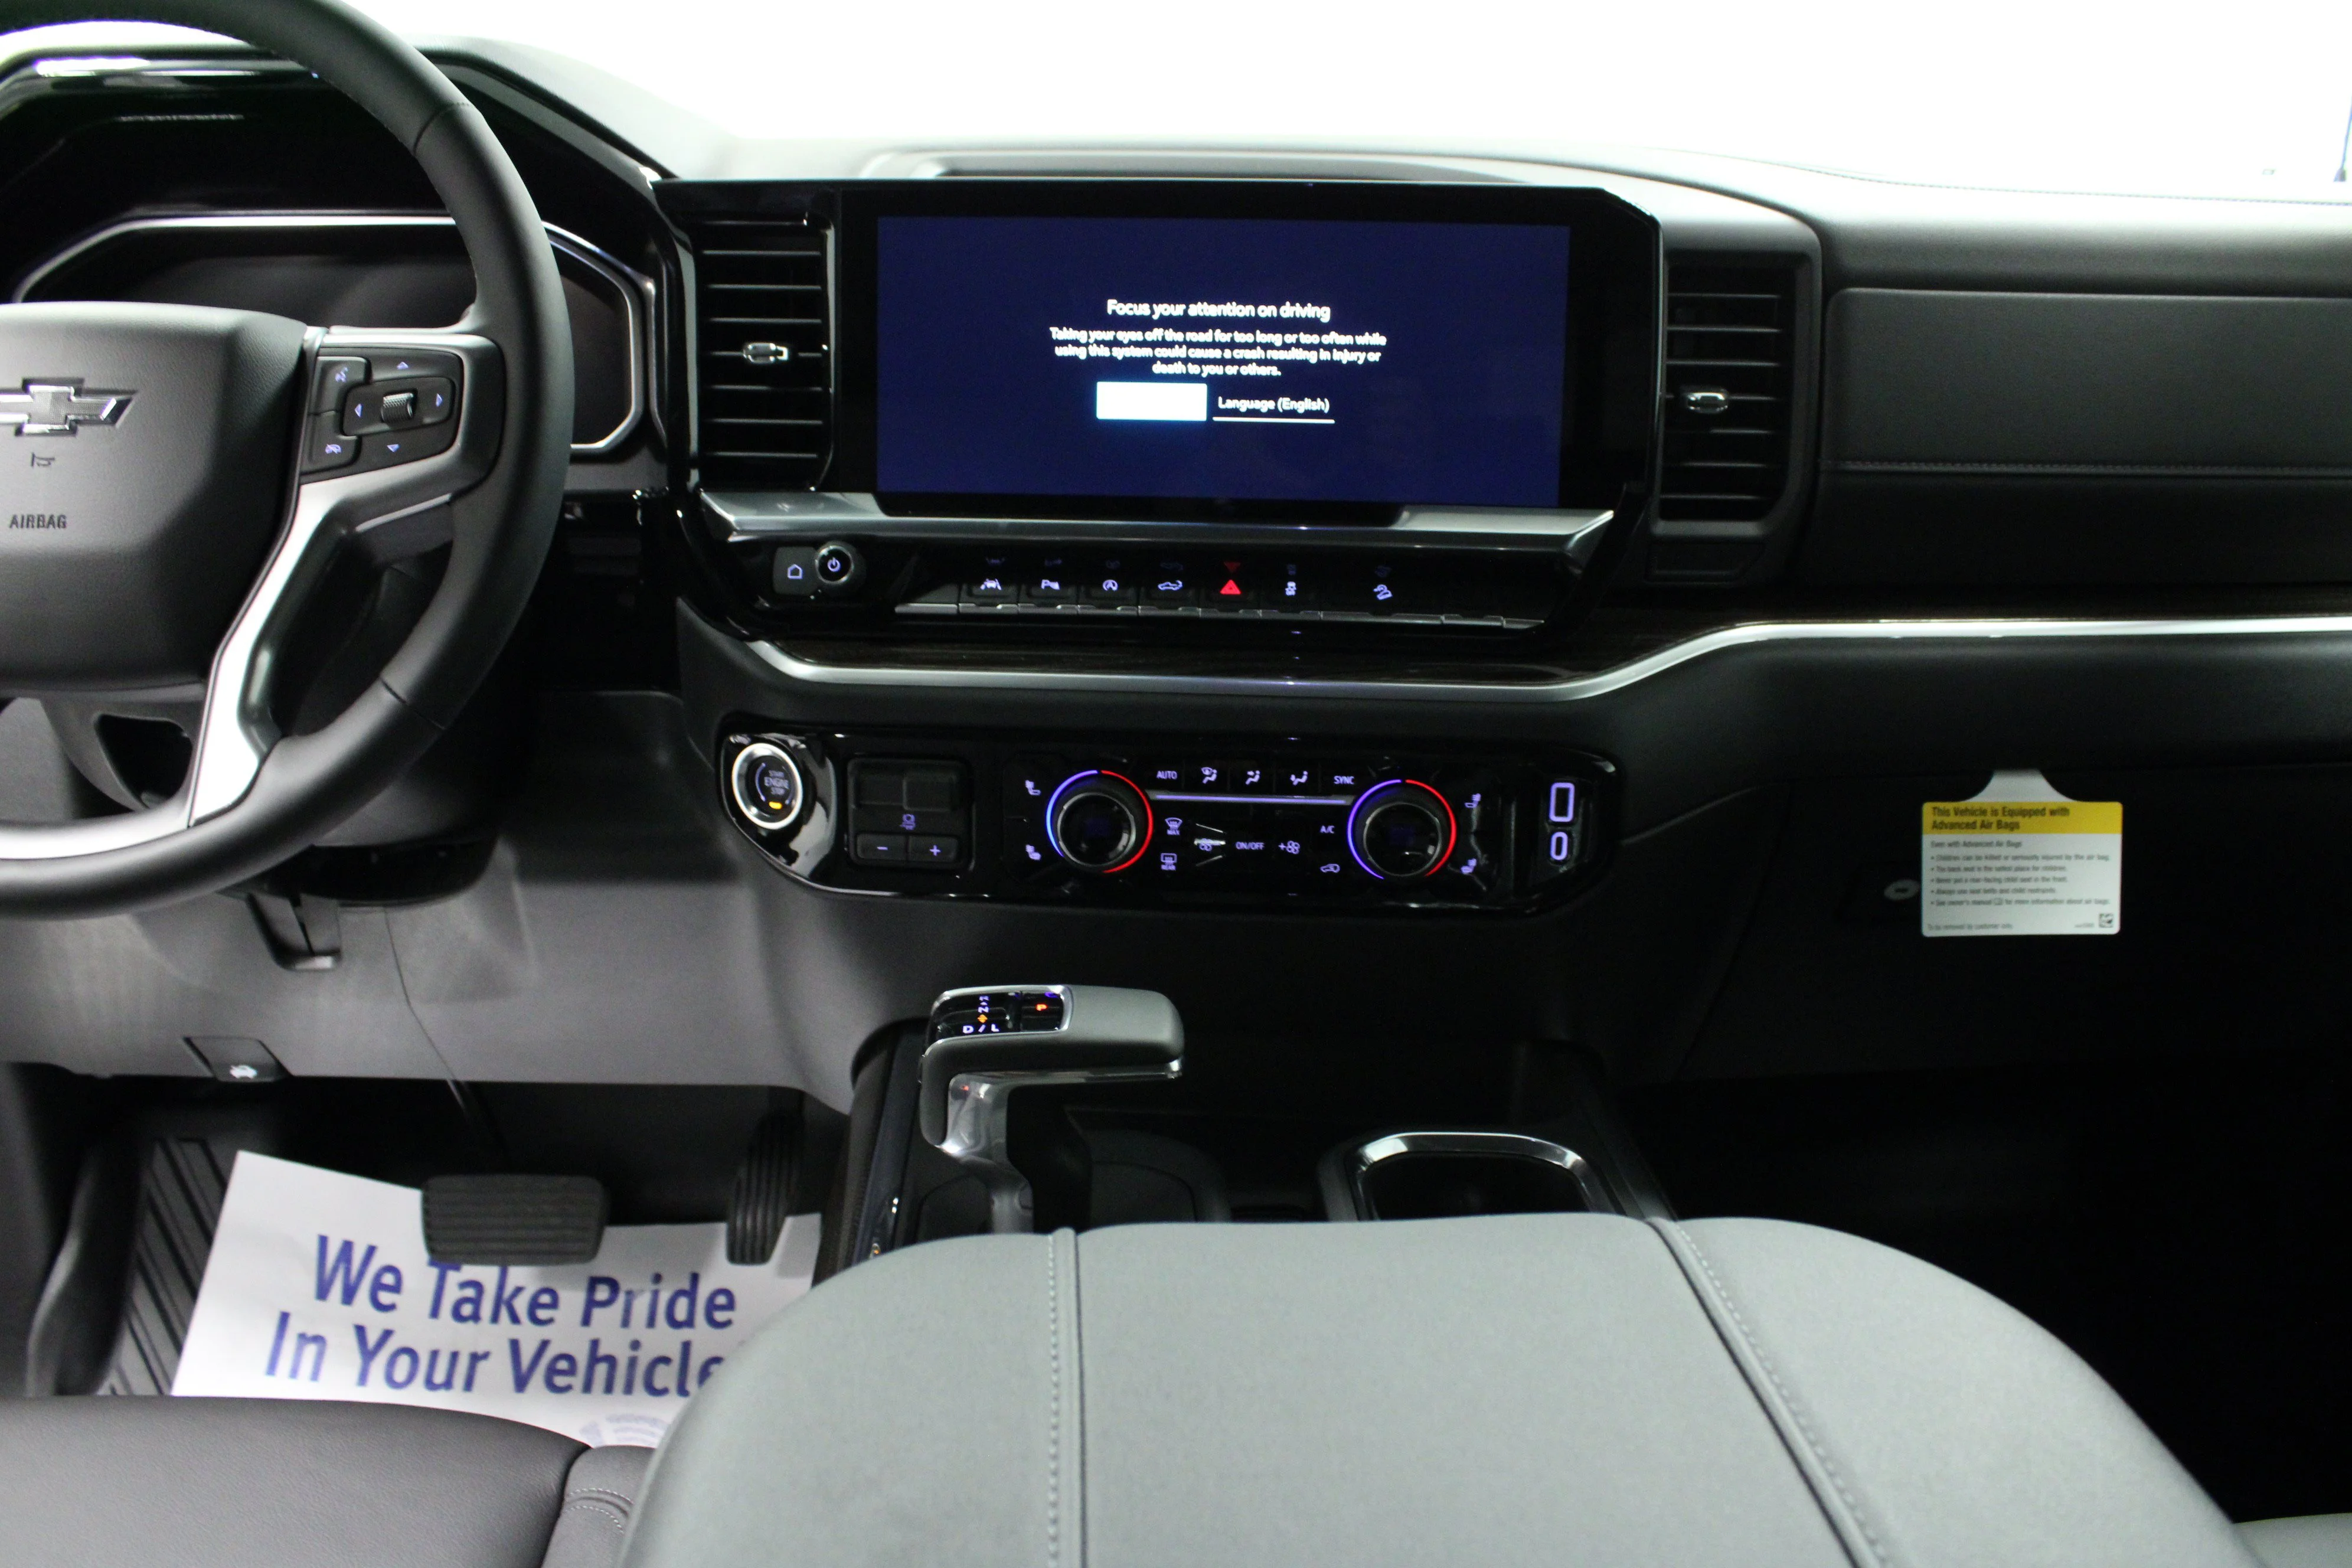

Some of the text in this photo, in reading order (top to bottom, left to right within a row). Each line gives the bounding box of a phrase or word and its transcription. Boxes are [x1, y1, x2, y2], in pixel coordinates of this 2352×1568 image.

[1107, 299, 1331, 322] Focus your attention on driving
[1050, 327, 1387, 346] Taking your eyes off the road for too long or too often while
[1055, 344, 1381, 364] using this system could cause a crash resulting in injury or
[1152, 361, 1281, 377] death to you or others.
[1218, 397, 1330, 413] Language (English)
[9, 514, 67, 529] AIRBAG
[1157, 770, 1178, 780] AUTO
[1334, 775, 1355, 785] SYNC
[1932, 806, 2070, 818] This Vehicle is Equipped with
[1319, 825, 1335, 834] A/C
[1932, 819, 2020, 832] Advanced Air Bags
[1236, 841, 1265, 851] ON/OFF
[315, 1234, 736, 1329] We Take Pride
[264, 1311, 328, 1381] In
[354, 1324, 489, 1392] Your
